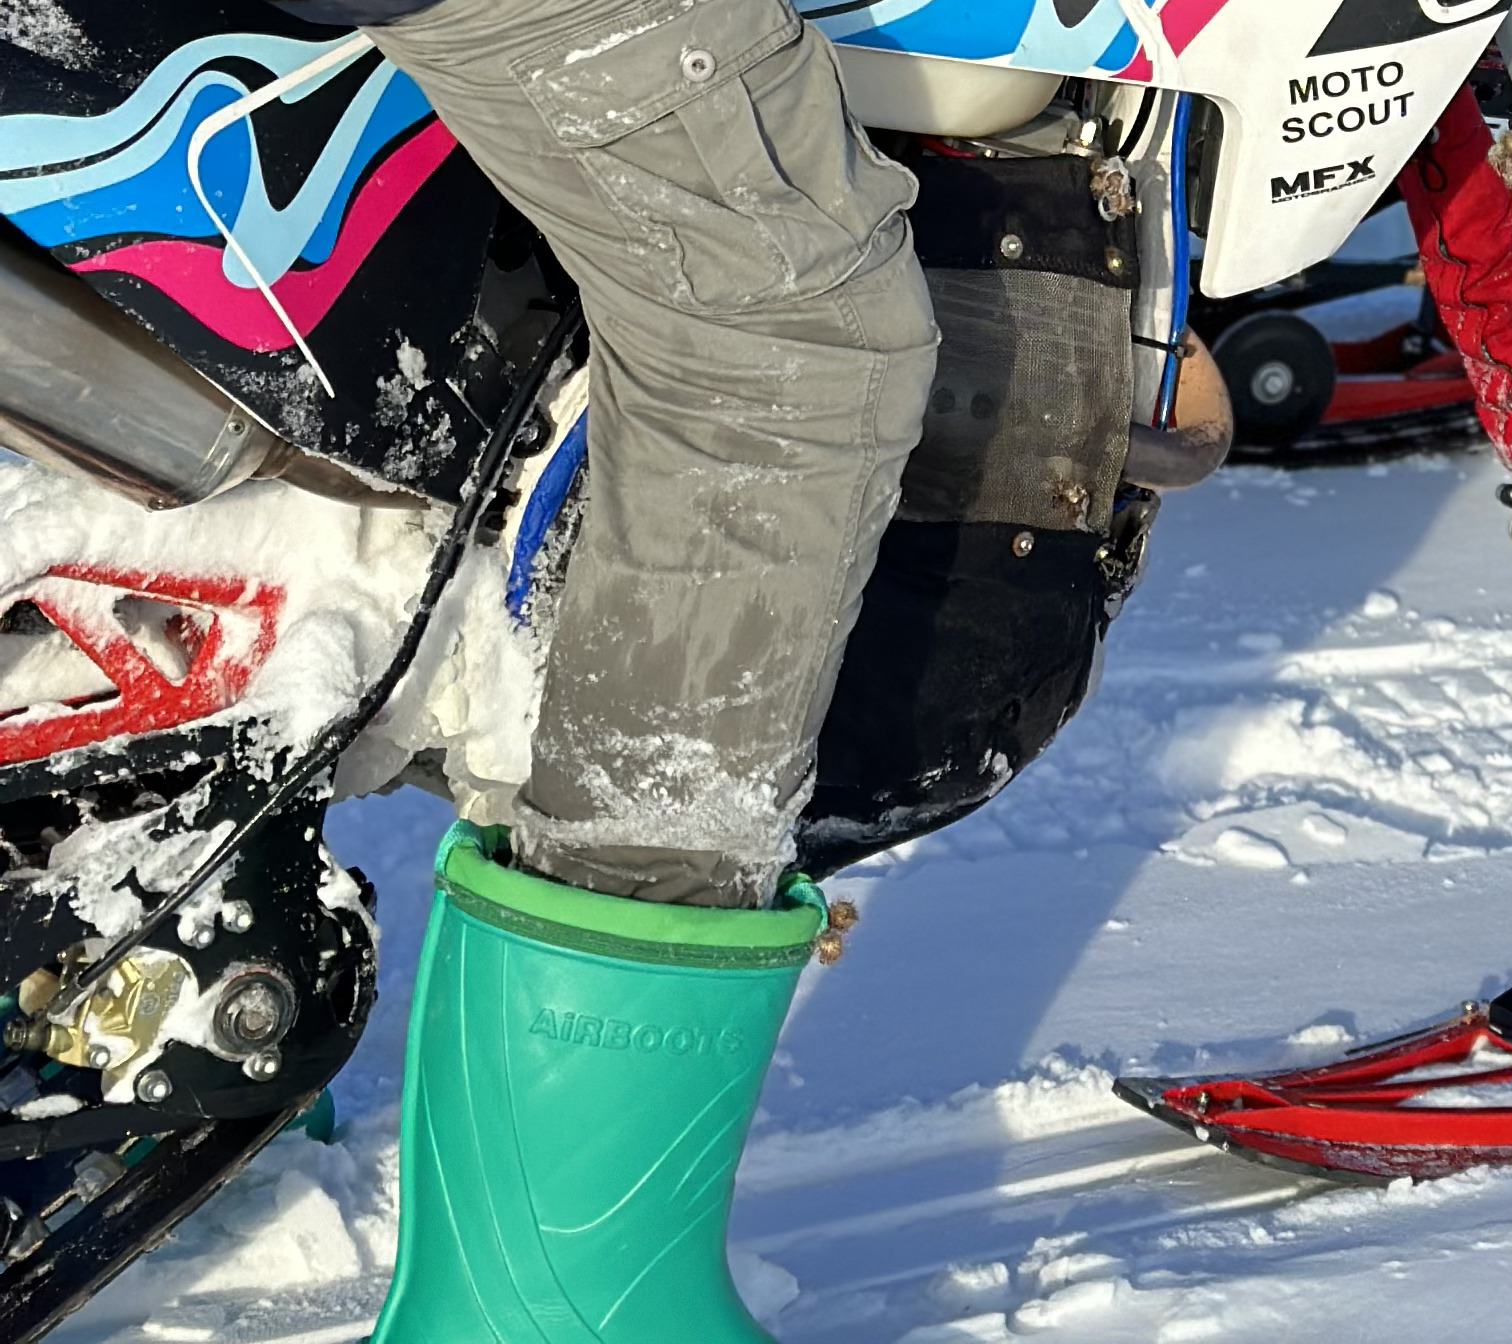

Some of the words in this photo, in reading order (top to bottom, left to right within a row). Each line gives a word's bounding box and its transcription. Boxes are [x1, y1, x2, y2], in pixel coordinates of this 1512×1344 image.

[1289, 61, 1404, 105] MOTO
[1282, 91, 1415, 143] SCOUT
[1270, 154, 1375, 199] MFX
